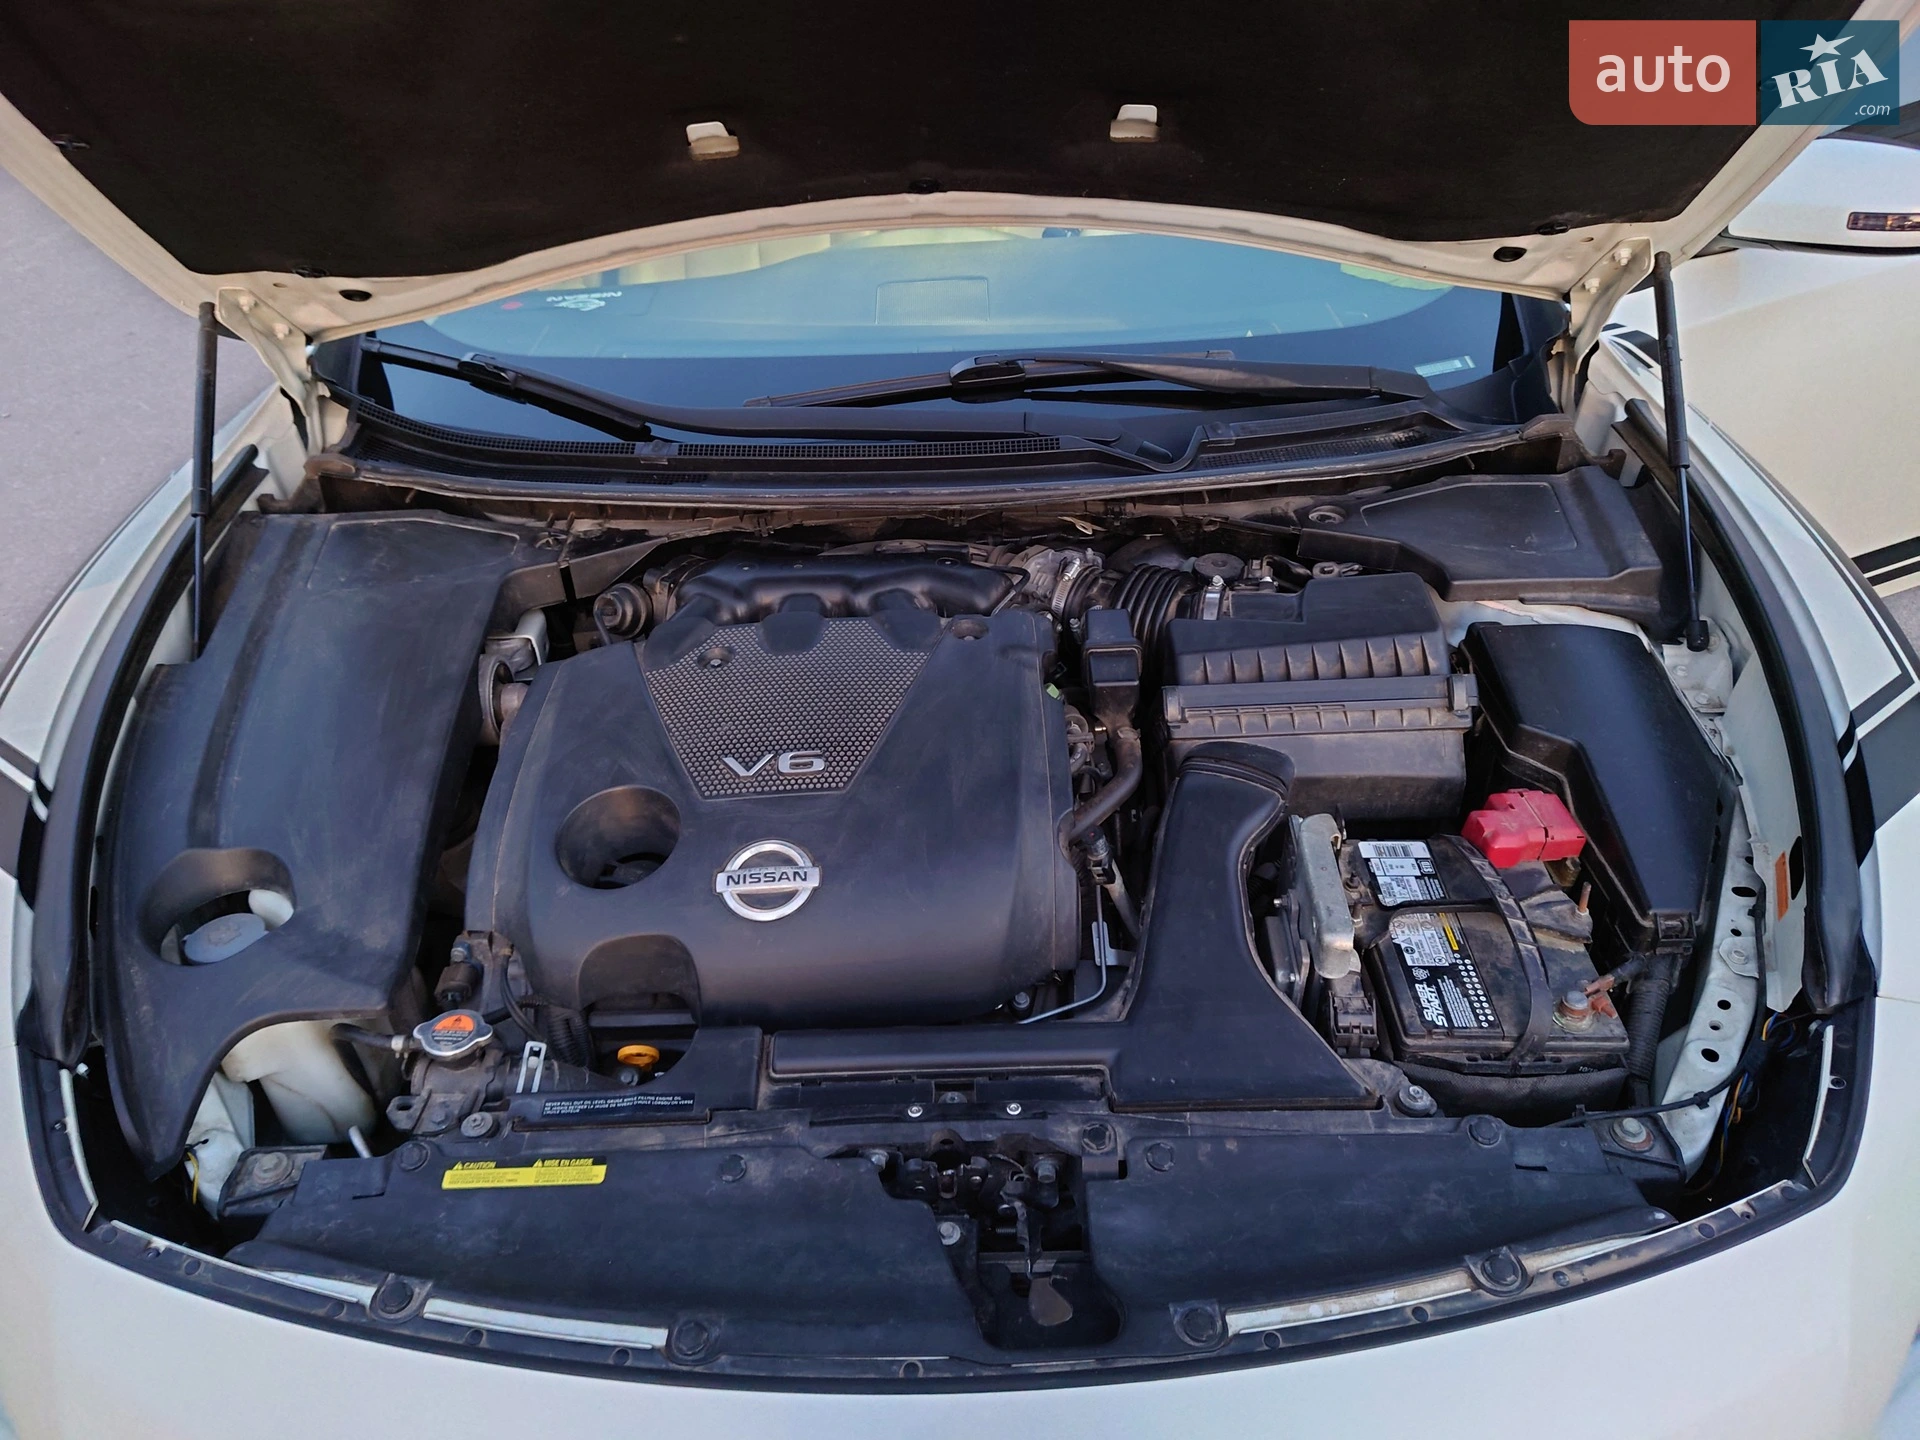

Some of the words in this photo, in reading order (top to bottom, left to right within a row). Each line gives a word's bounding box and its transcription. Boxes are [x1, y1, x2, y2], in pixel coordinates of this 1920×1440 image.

[721, 750, 826, 778] V6
[726, 870, 808, 886] NISSAN
[1415, 983, 1433, 1021] SUPER
[1425, 984, 1448, 1027] START
[463, 1161, 497, 1169] CAUTION
[543, 1159, 560, 1167] MISE
[570, 1158, 594, 1166] GARDE
